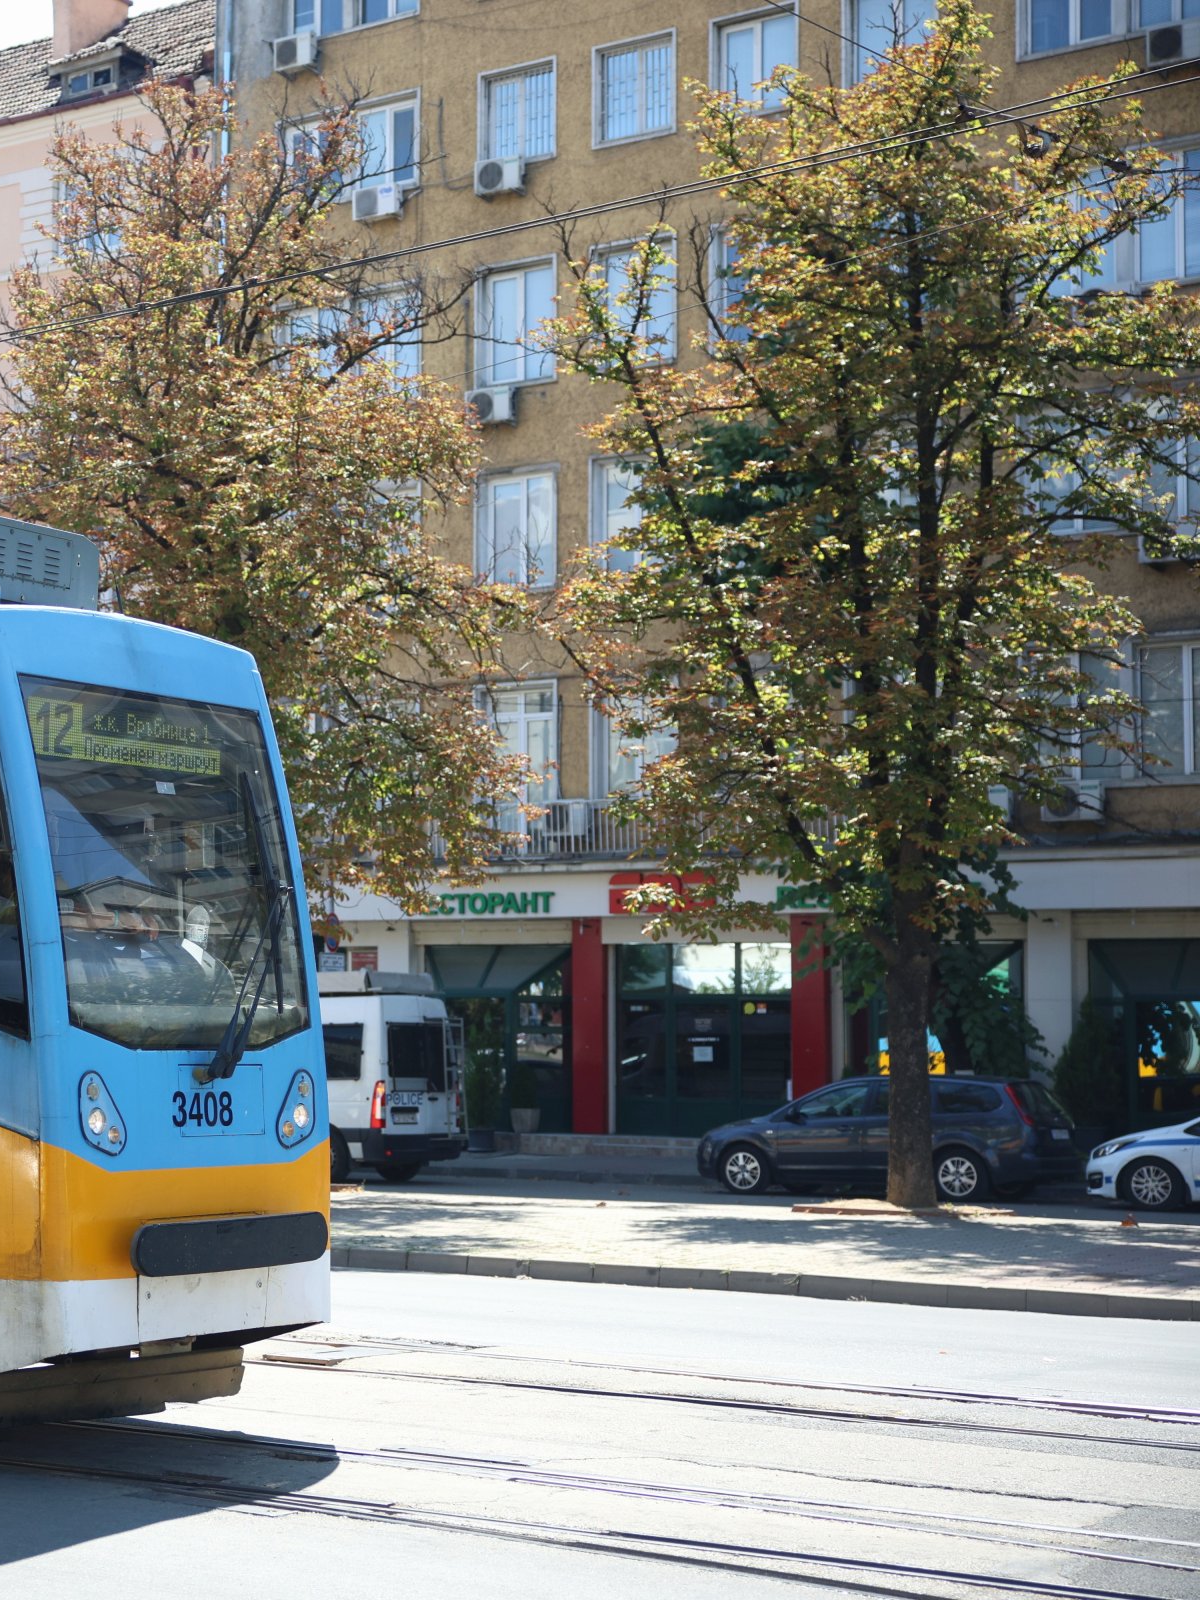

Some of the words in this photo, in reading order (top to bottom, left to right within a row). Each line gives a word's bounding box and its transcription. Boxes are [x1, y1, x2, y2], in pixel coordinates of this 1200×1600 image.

[36, 703, 73, 754] 12
[202, 723, 210, 745] 1
[172, 1091, 233, 1127] 3408
[386, 1093, 423, 1106] POLICE
